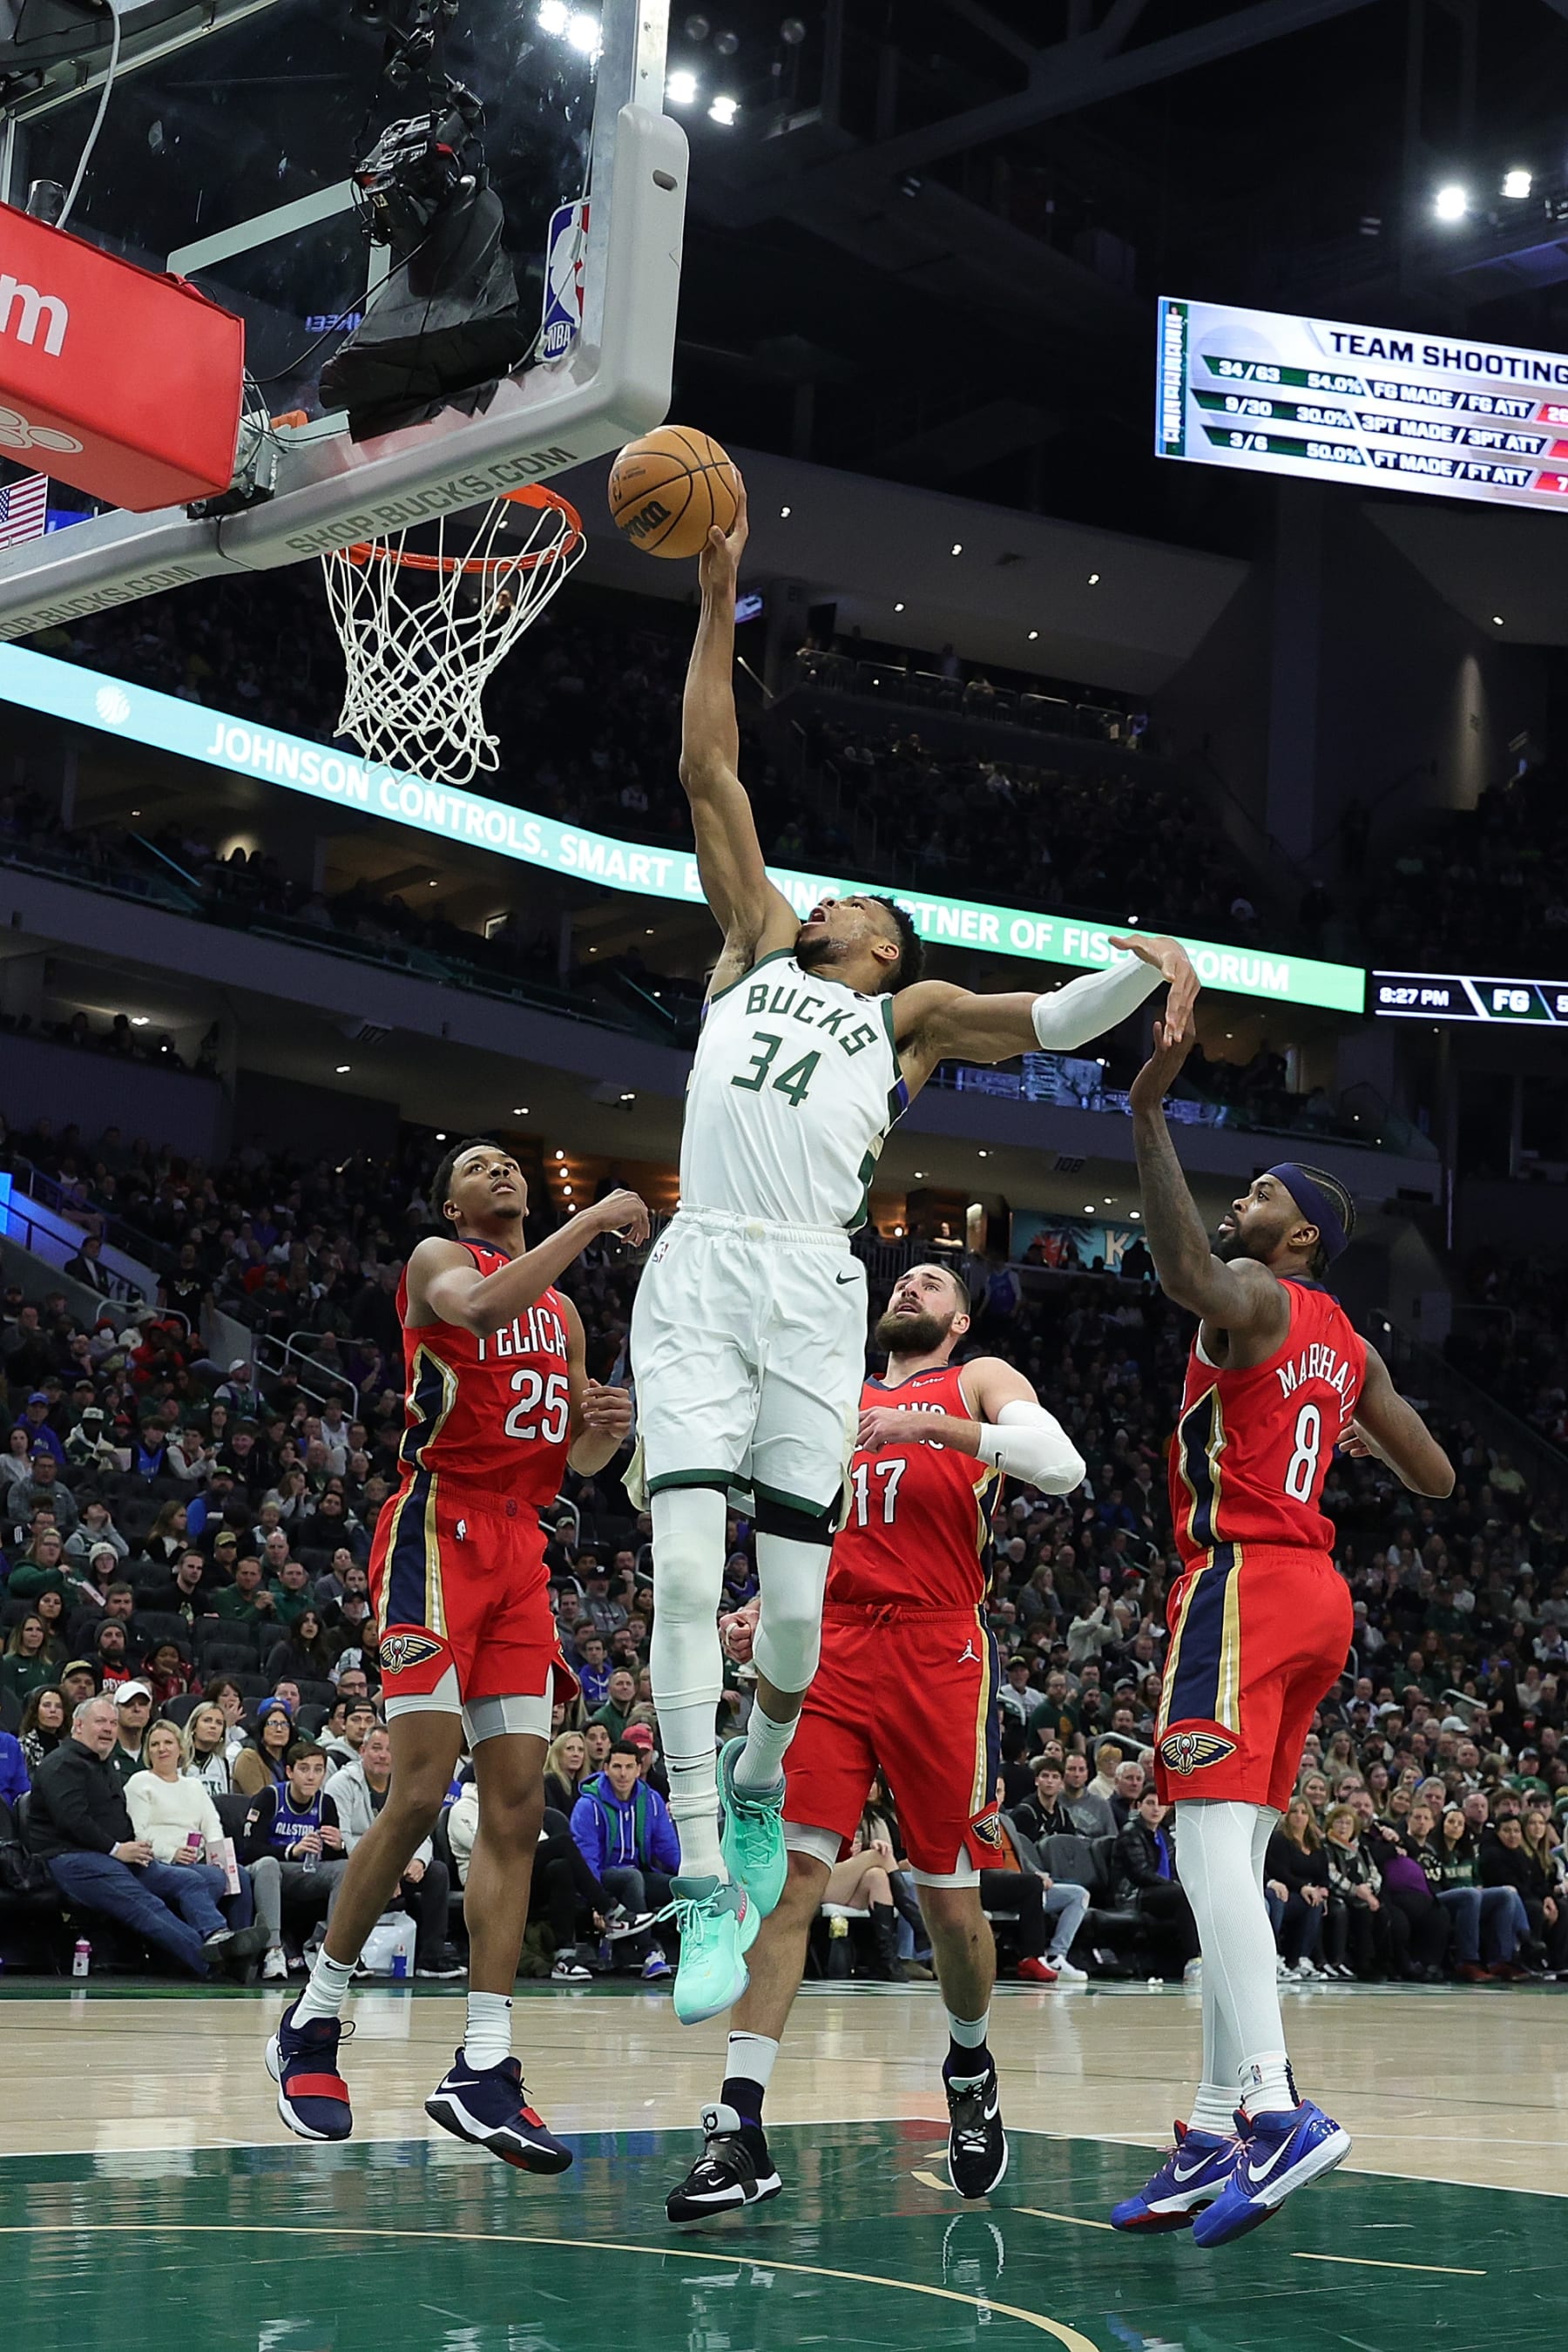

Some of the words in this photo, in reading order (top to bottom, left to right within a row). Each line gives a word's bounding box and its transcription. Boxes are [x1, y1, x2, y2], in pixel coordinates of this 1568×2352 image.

[547, 323, 571, 352] NBA
[1329, 331, 1414, 362] TEAM
[1423, 345, 1568, 384] SHOOTING
[1219, 360, 1281, 382] 34/63
[1308, 372, 1362, 395] 54.0%
[1374, 382, 1398, 399] FG
[1400, 386, 1454, 408] MADE
[1468, 395, 1493, 413] FG
[1494, 399, 1530, 419] ATT
[1225, 396, 1273, 416] 9/30
[1296, 406, 1351, 428] 30.0%
[1362, 415, 1399, 434] 3PT
[1400, 420, 1454, 443] MADE
[1468, 429, 1505, 449] 3PT
[1505, 435, 1541, 454] ATT
[1229, 432, 1268, 451] 3/6
[1307, 443, 1362, 464] 50.0%
[1374, 450, 1398, 468] FT
[1399, 454, 1454, 476] MADE
[1467, 463, 1492, 481] FT
[1492, 467, 1528, 486] ATT
[285, 446, 578, 553] SHOP.BUCKS.COM
[0, 566, 200, 640] OP.BUCKS.COM
[207, 722, 370, 802] JOHNSON
[379, 781, 549, 858] CONTROLS.
[558, 834, 673, 888] SMART
[1010, 918, 1053, 951] OF
[746, 983, 879, 1057] BUCKS
[1379, 987, 1419, 1004] 8:27
[1421, 989, 1450, 1007] PM
[1492, 989, 1531, 1012] FG
[730, 1031, 823, 1108] 34
[504, 1369, 569, 1443] 25
[1285, 1402, 1321, 1504] 8
[851, 1458, 907, 1527] 17
